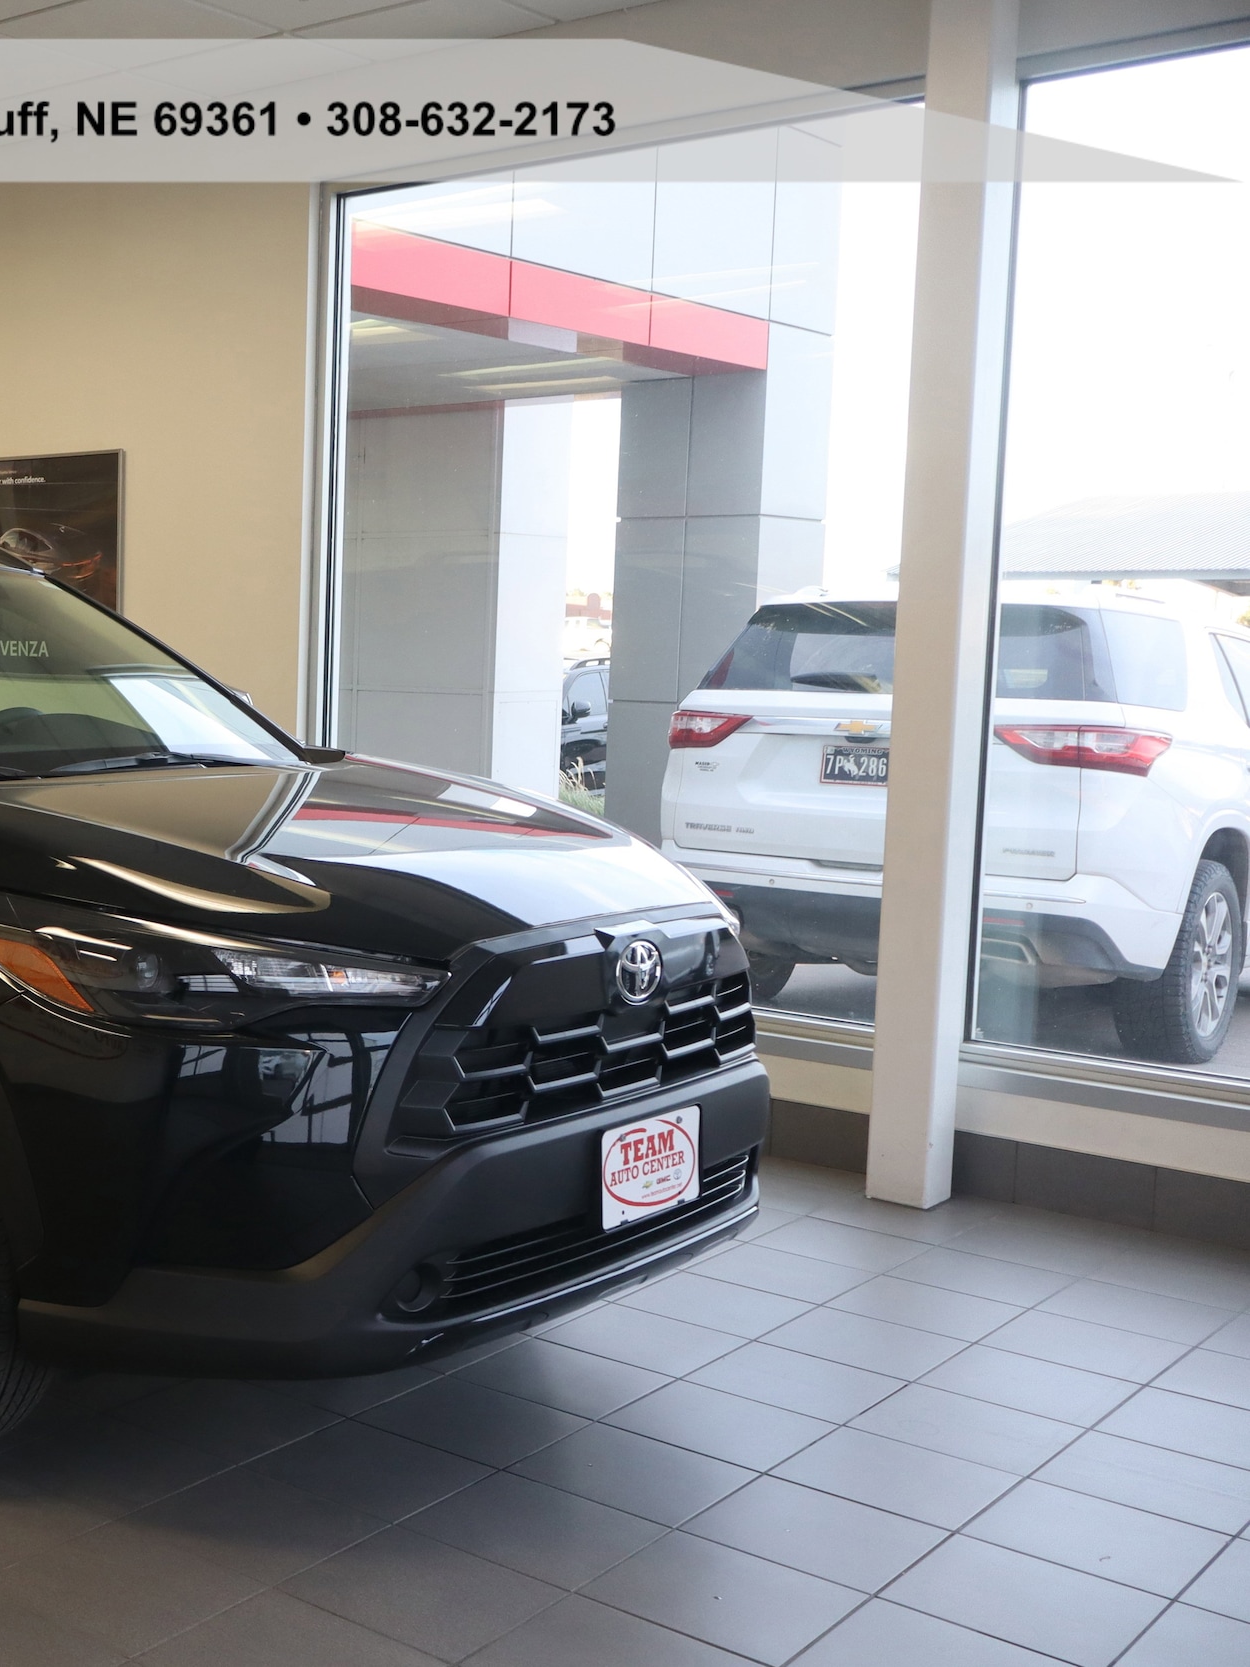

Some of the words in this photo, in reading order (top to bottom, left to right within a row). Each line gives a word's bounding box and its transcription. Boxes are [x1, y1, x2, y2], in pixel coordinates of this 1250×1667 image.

[2, 476, 14, 485] with
[0, 640, 49, 657] VENZA
[842, 747, 883, 755] WYOMING
[858, 756, 887, 777] 286
[620, 1128, 675, 1166] TEAM
[610, 1164, 639, 1187] AUTO
[642, 1150, 685, 1176] CENTER
